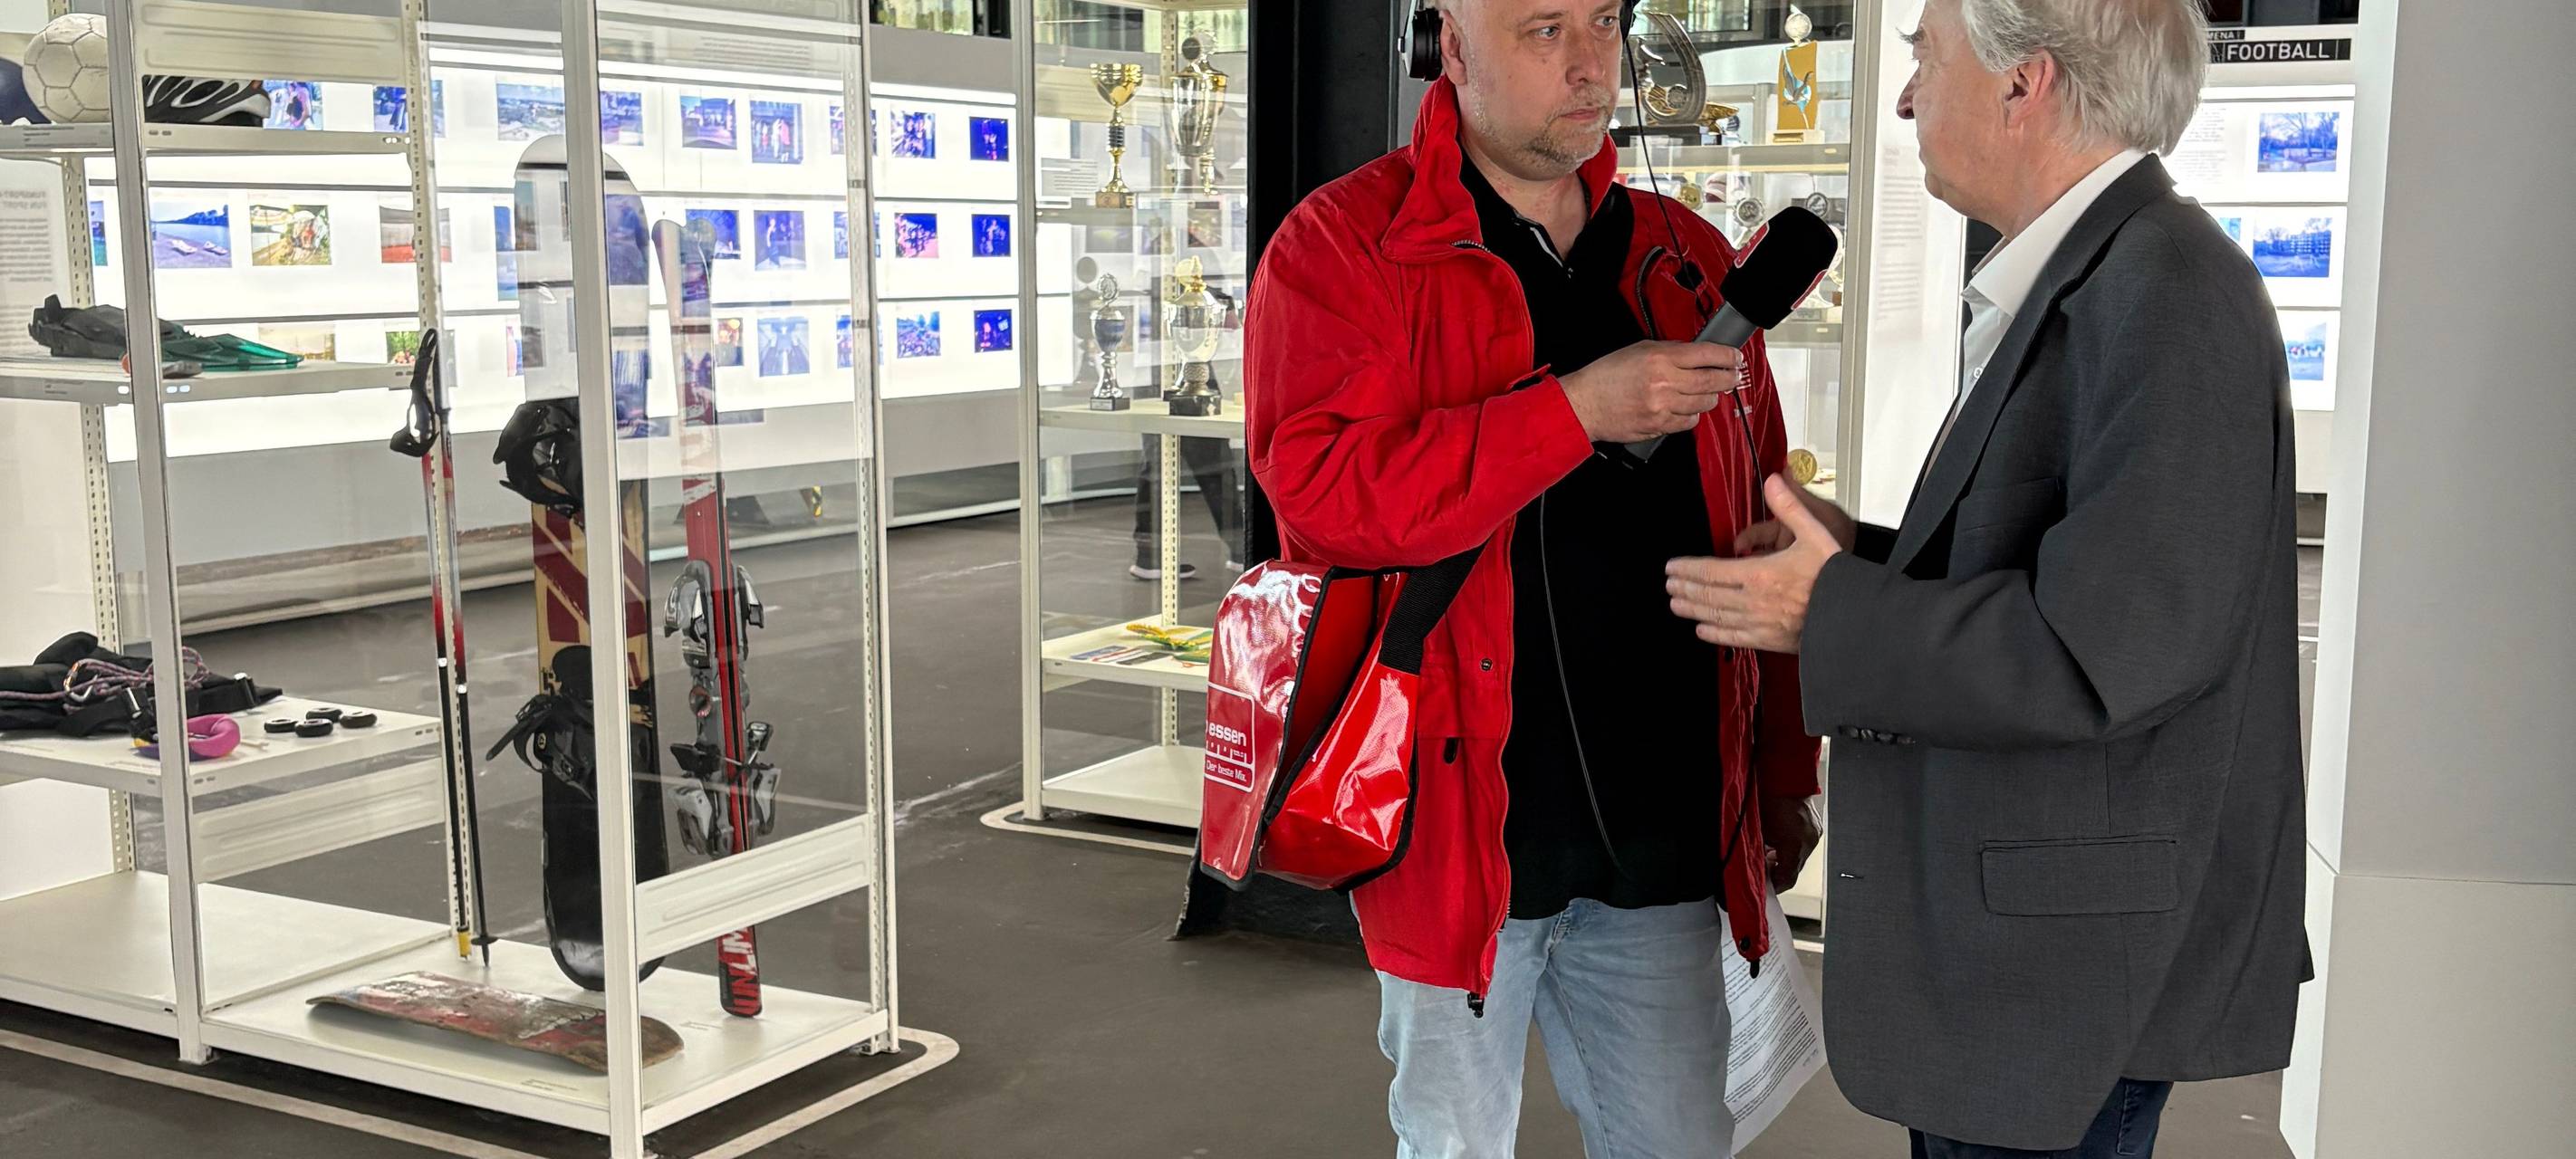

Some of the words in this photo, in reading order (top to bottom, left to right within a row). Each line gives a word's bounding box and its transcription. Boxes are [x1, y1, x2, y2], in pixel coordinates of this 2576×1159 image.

[2226, 42, 2330, 61] FOOTBALL
[1209, 723, 1246, 746] essen
[1206, 760, 1217, 771] Der
[1217, 763, 1234, 778] beste
